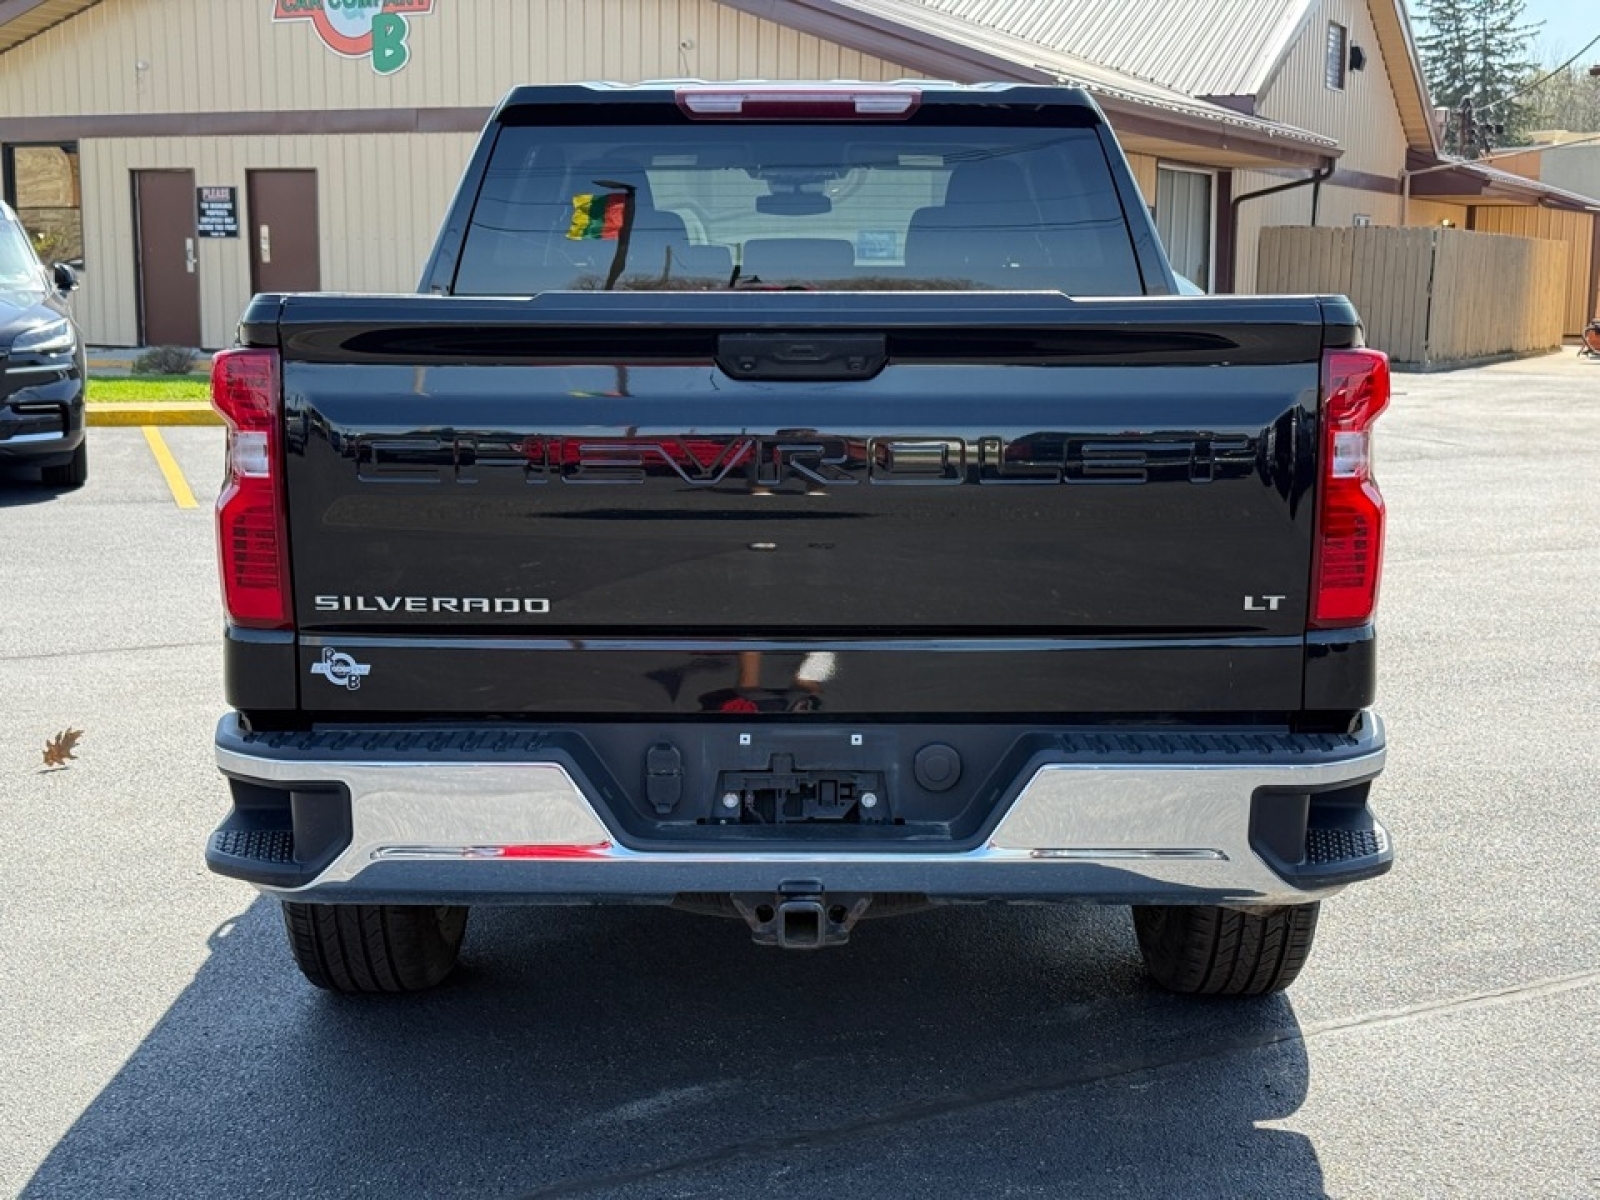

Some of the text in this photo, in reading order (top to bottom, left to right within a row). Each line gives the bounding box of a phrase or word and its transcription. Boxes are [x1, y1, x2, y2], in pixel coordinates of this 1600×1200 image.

[372, 12, 407, 73] B
[356, 434, 1249, 484] CHEVROLET
[314, 594, 551, 613] SILVERADO
[1244, 594, 1286, 611] LT
